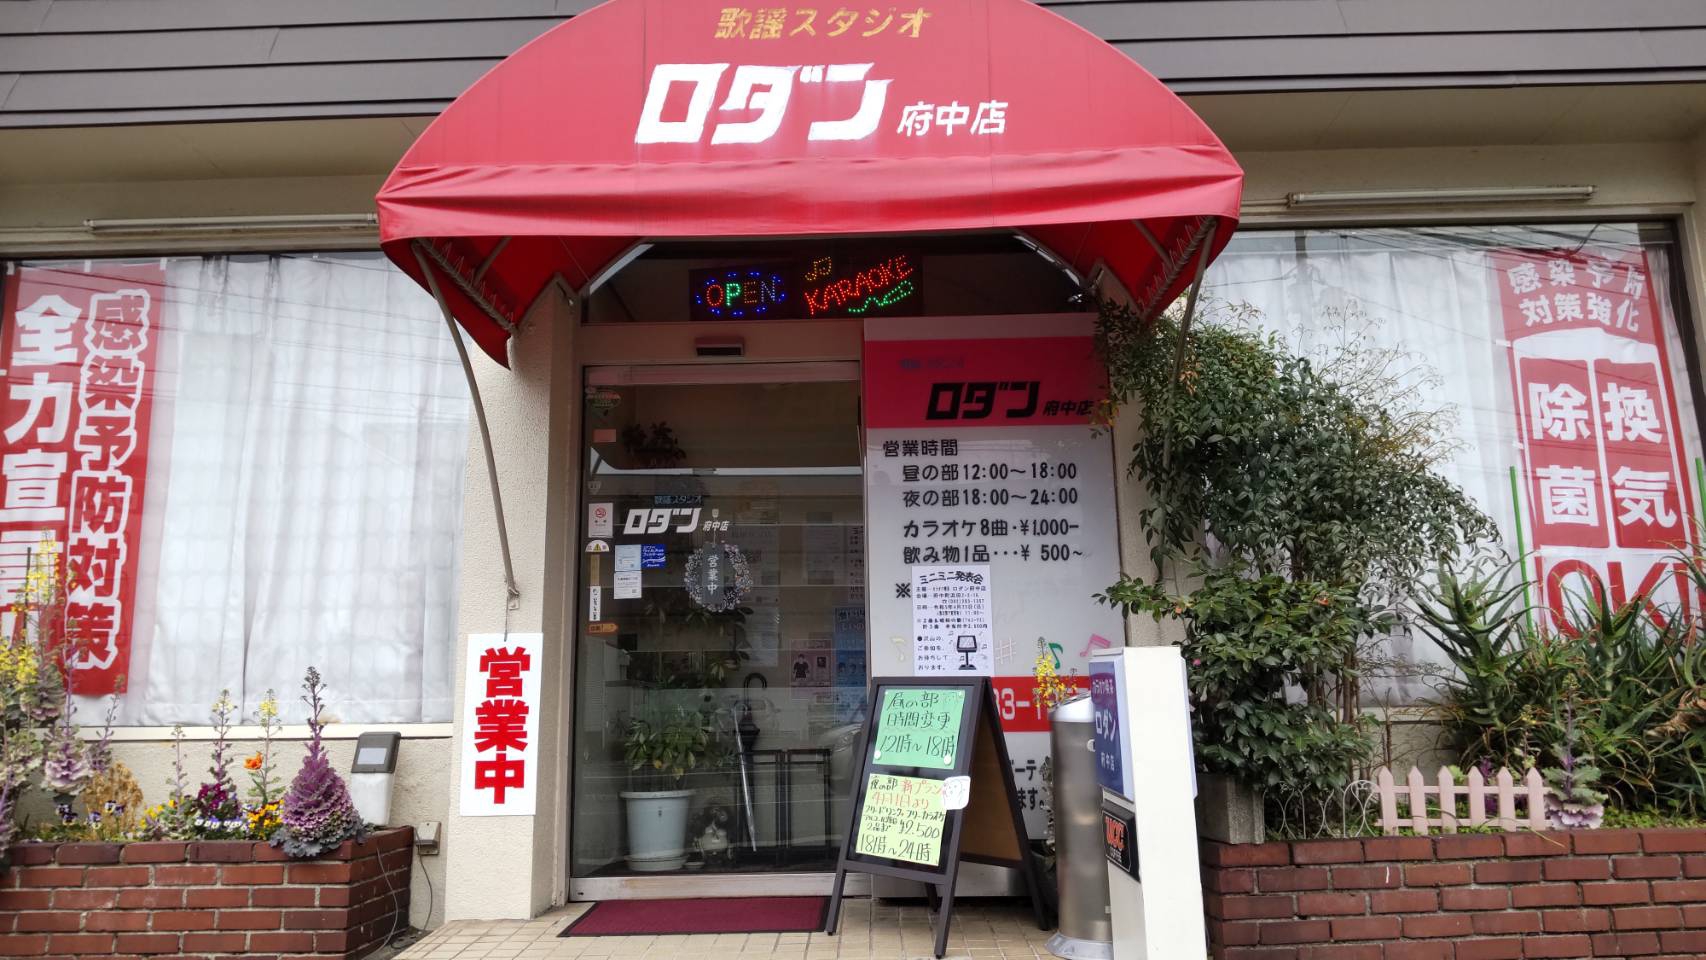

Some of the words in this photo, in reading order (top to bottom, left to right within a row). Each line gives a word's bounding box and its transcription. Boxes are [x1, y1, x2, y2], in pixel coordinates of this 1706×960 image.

[714, 5, 932, 41] 歌謡スタジオ
[635, 62, 893, 145] ロダン
[896, 100, 1009, 137] 府中店
[705, 279, 780, 308] OPEN
[803, 254, 913, 316] KARAOKE
[1519, 292, 1640, 332] 対策強化
[925, 381, 1040, 420] ロダン
[1043, 400, 1094, 417] 府中店
[882, 439, 959, 458] 営業時間
[1528, 382, 1600, 527] 除菌
[1602, 381, 1677, 529] 換気
[64, 288, 150, 670] 感染予防対策
[622, 507, 703, 535] ロダン
[919, 571, 984, 585] ミニミニ発表会
[887, 690, 940, 711] 昼の部
[473, 646, 531, 806] 営業中
[886, 711, 951, 731] 時間変更
[1096, 708, 1117, 742] ロダン
